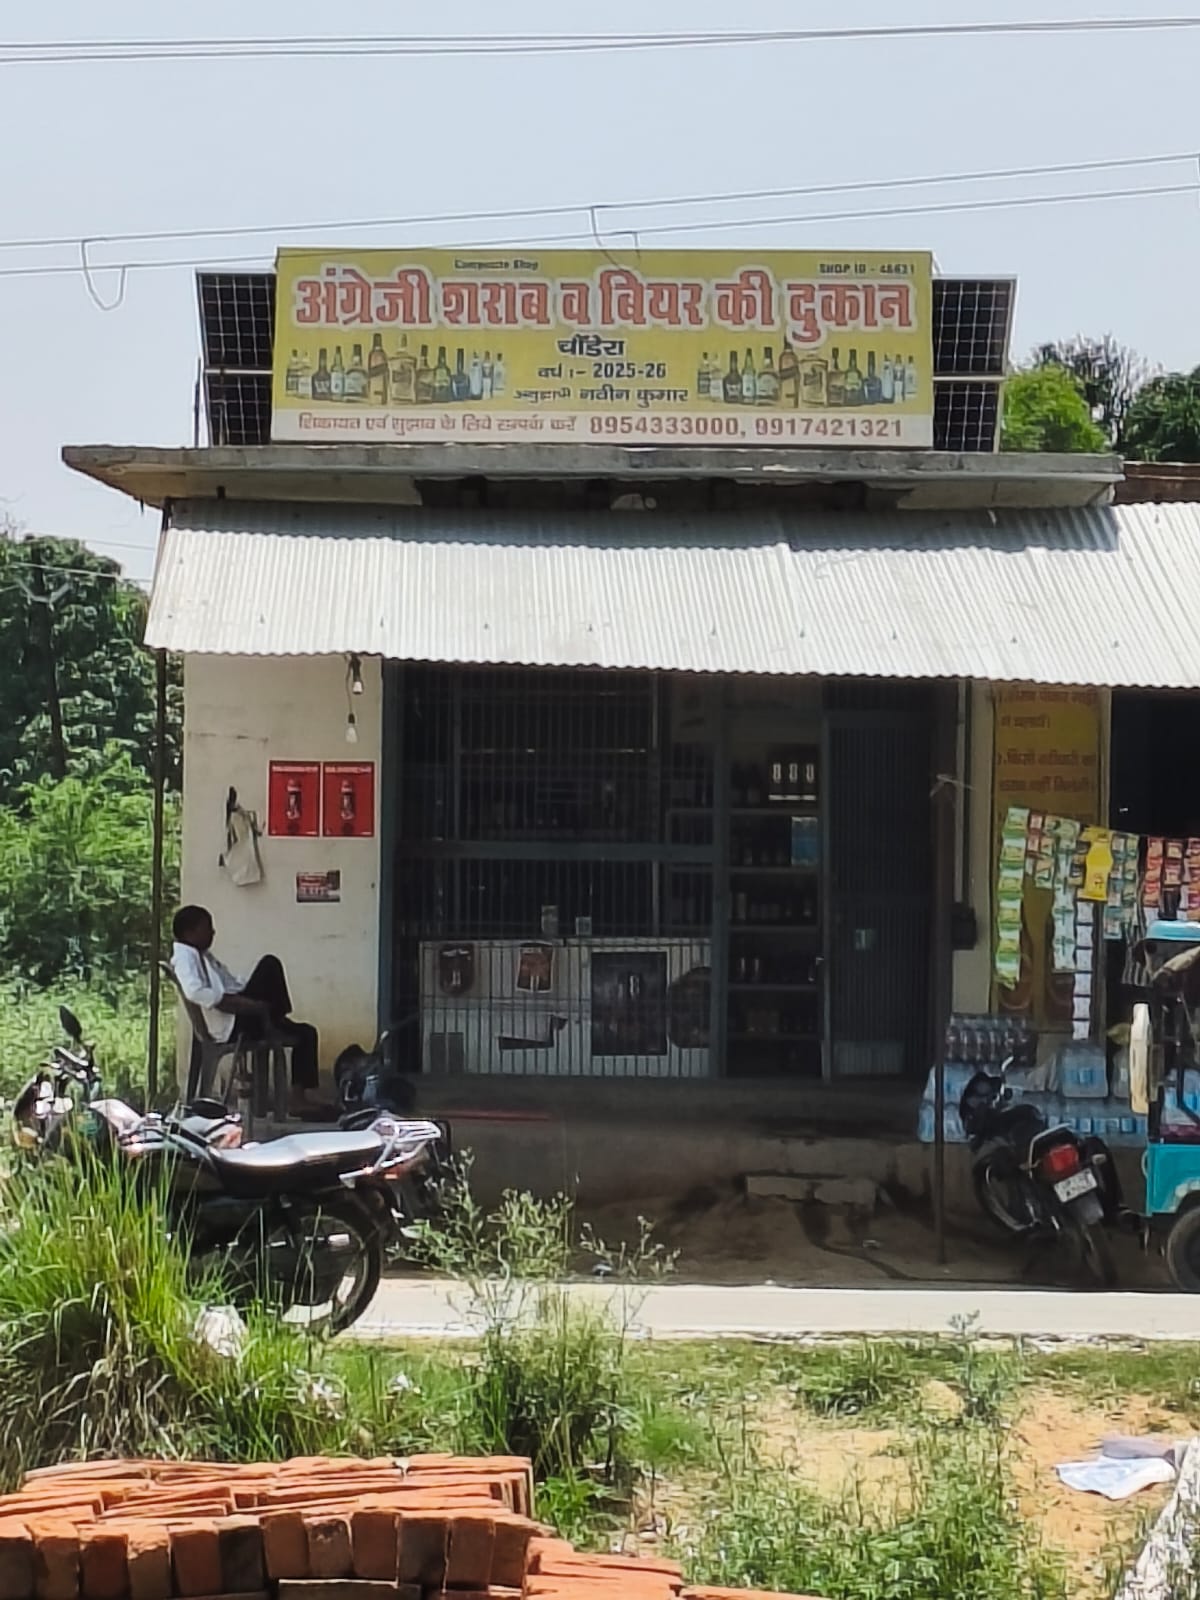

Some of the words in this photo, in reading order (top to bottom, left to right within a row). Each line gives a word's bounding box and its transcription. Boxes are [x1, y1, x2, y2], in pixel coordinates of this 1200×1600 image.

[819, 263, 850, 274] SHOP
[295, 267, 431, 325] अंग्रेजी
[441, 281, 551, 325] शराब
[559, 281, 590, 325] व
[599, 269, 704, 325] बियर
[715, 269, 775, 325] की
[787, 283, 912, 343] दुकान
[593, 362, 666, 379] 2025-26
[579, 384, 630, 402] नवीन
[637, 388, 688, 408] कुमार
[299, 412, 361, 429] शिकायत
[392, 417, 436, 436] सुझाव
[441, 414, 456, 431] के
[551, 415, 577, 431] करें
